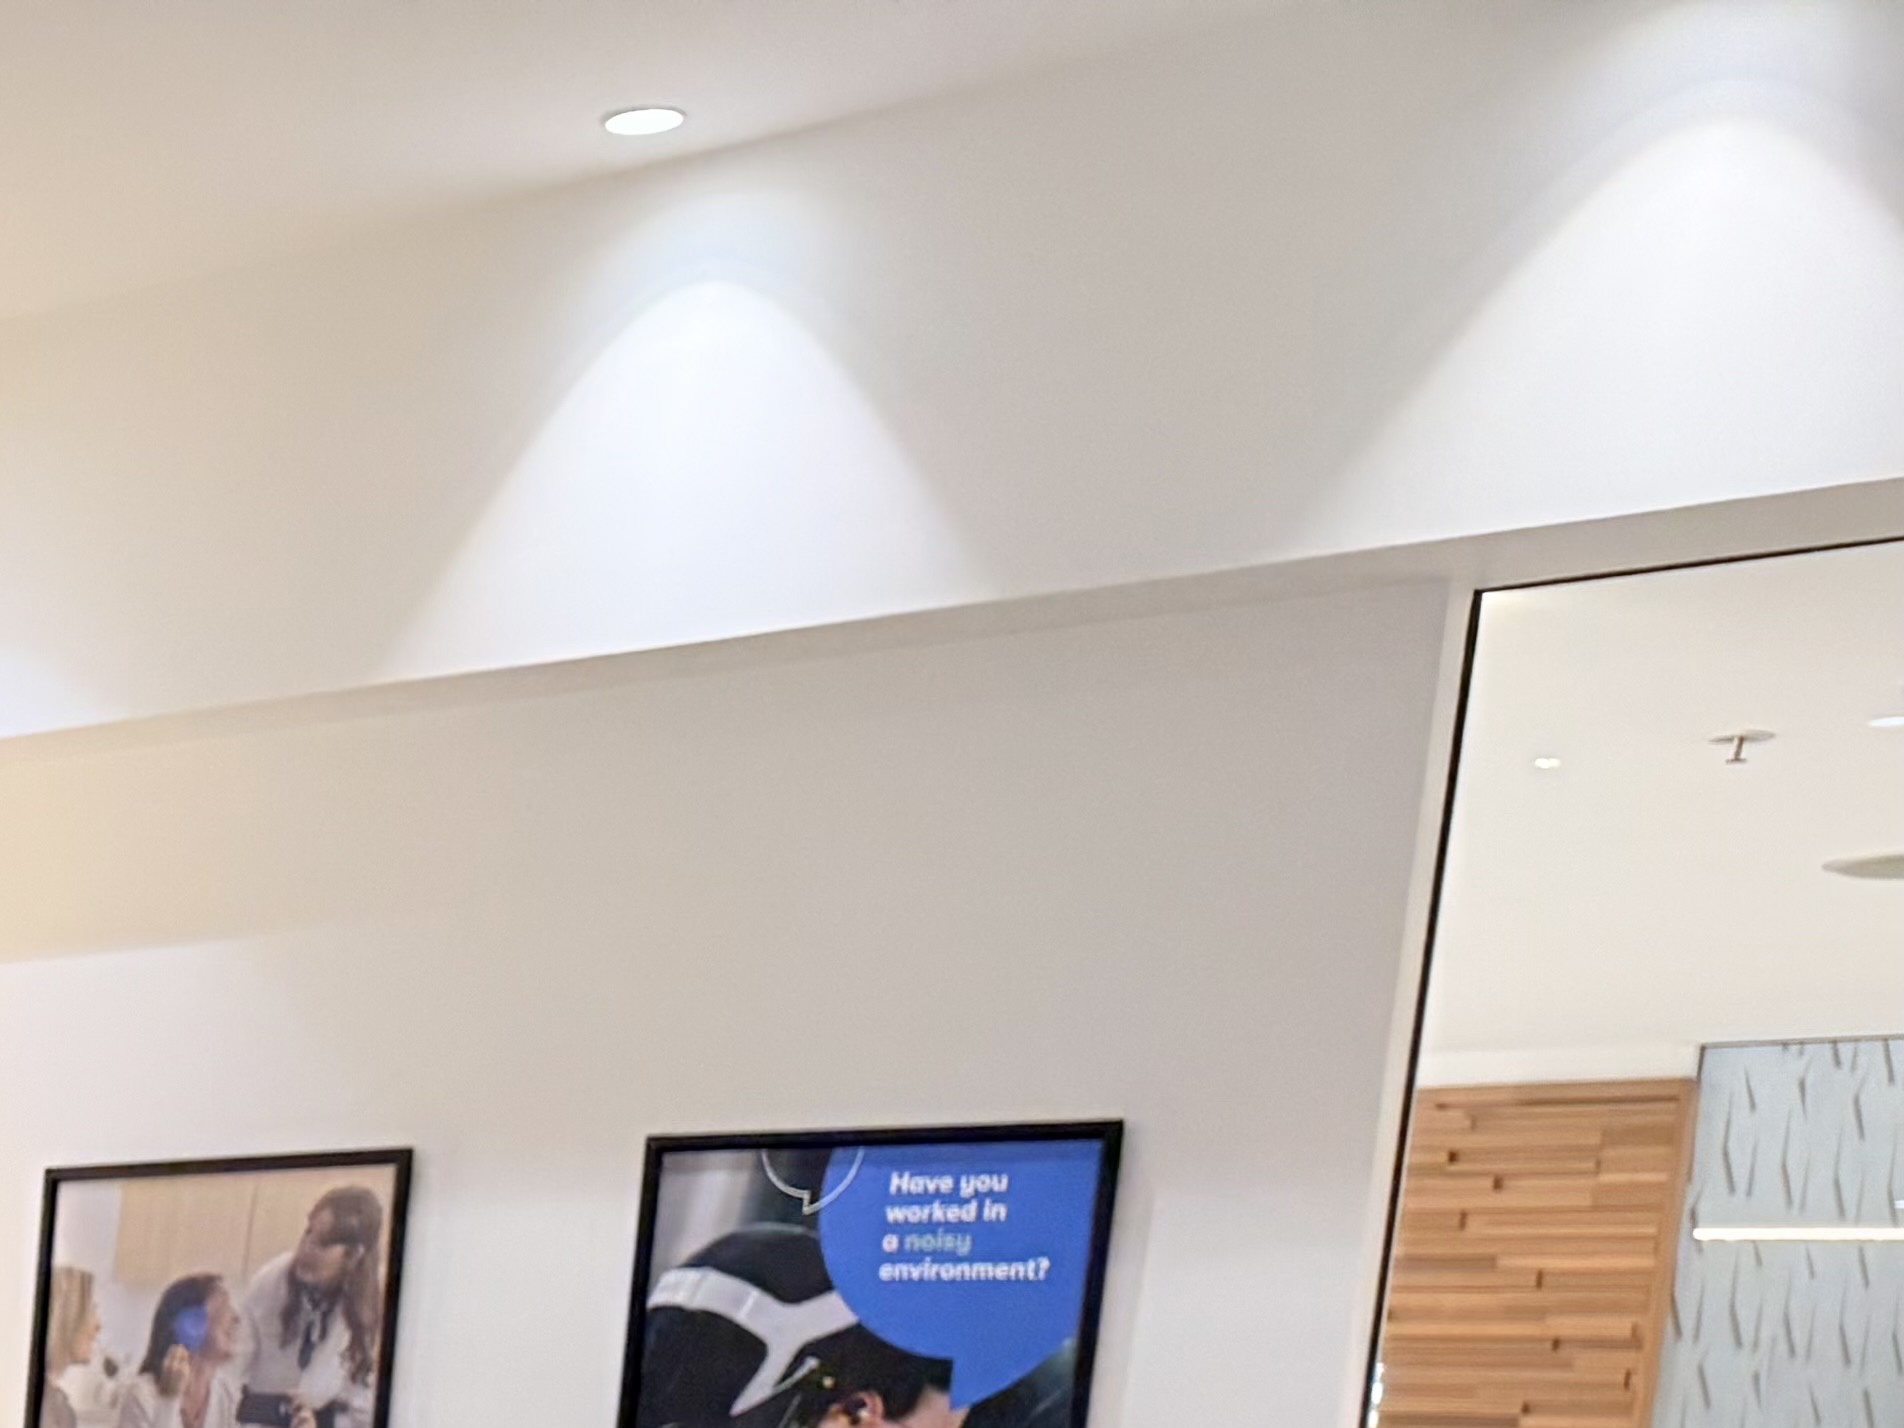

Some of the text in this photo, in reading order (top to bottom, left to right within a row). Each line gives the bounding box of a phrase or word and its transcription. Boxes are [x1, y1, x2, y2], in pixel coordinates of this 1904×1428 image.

[889, 1171, 1009, 1198] Have you
[885, 1198, 1008, 1223] worked in
[882, 1228, 972, 1256] a noisy
[878, 1257, 1052, 1282] environment?
